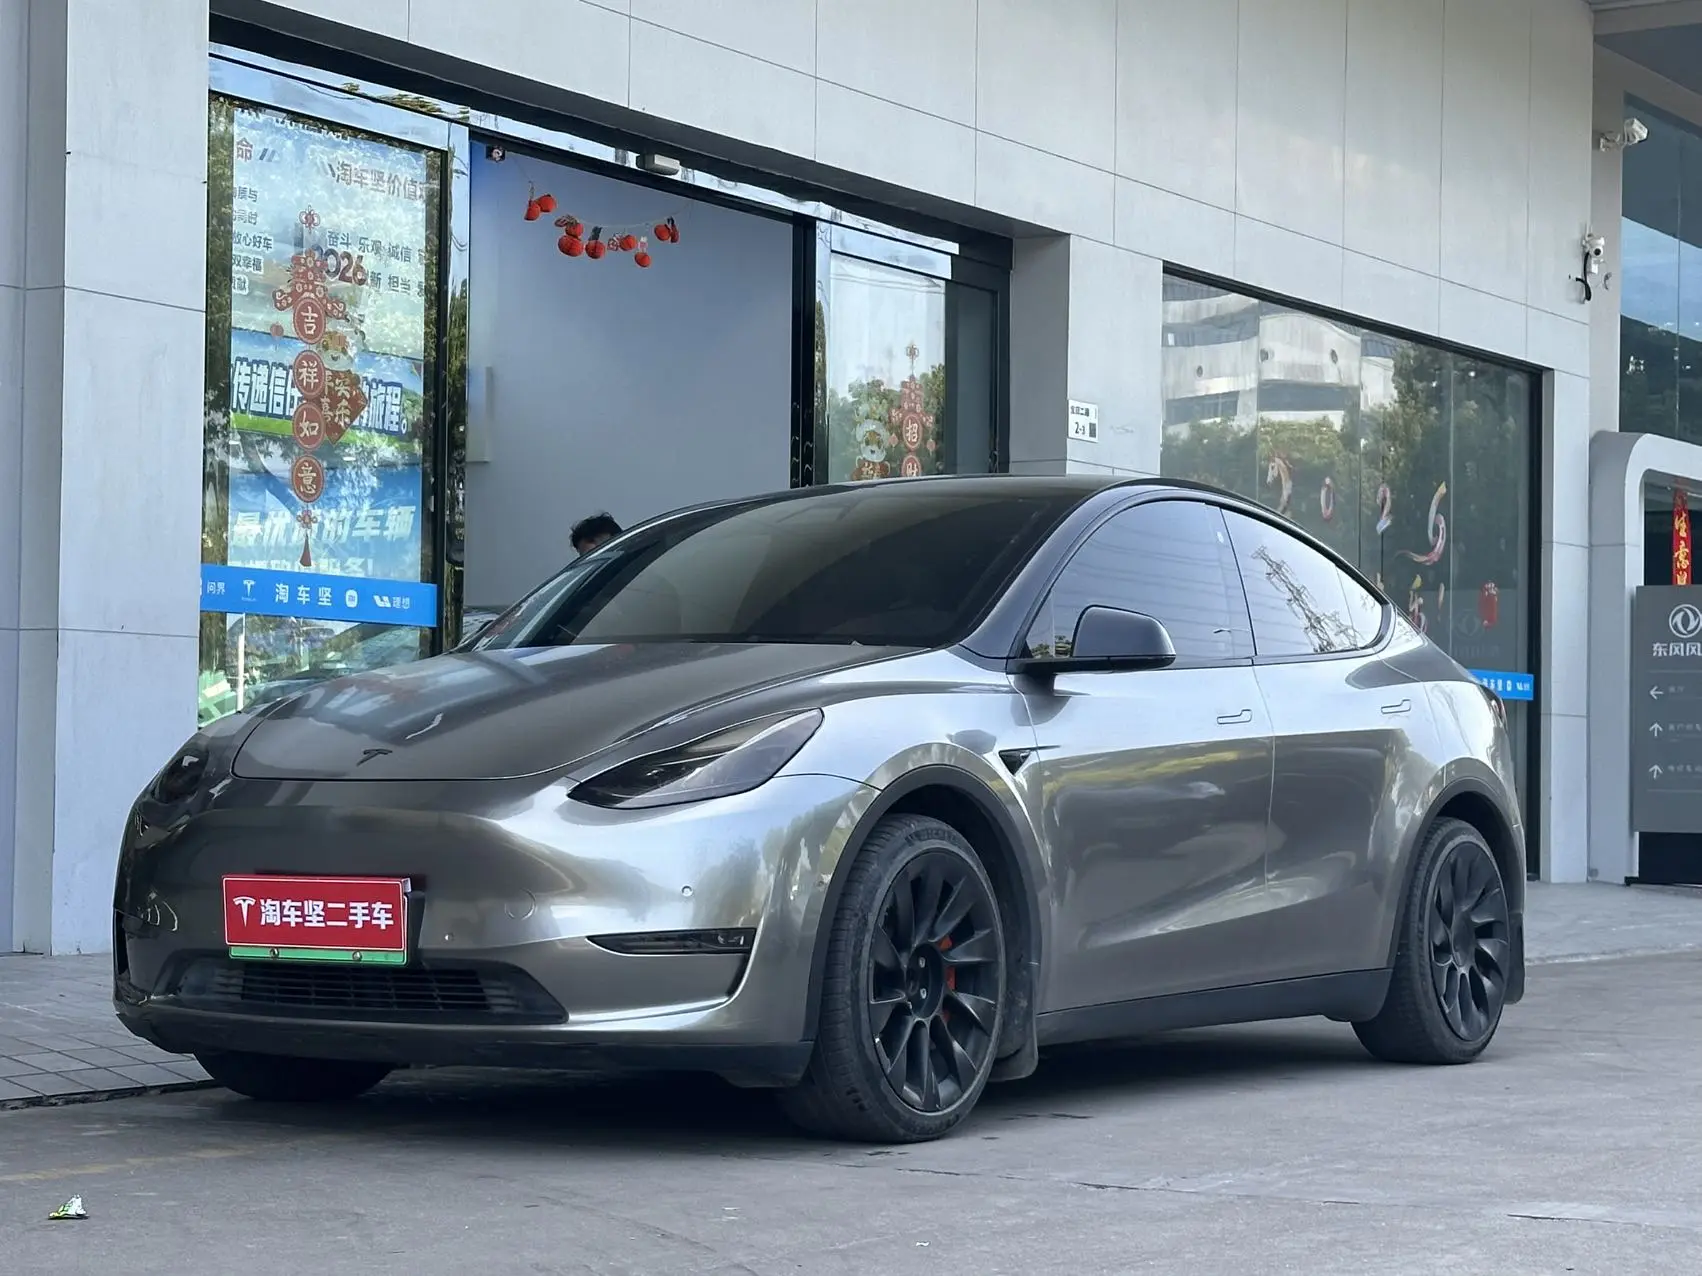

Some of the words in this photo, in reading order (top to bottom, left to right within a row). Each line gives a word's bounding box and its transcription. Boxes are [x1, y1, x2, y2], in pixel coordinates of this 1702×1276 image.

[388, 242, 412, 263] 诚信
[388, 273, 411, 295] 担当
[298, 307, 319, 494] 吉祥如意
[206, 581, 226, 596] 问界
[275, 583, 333, 607] 淘车坚
[1652, 642, 1702, 657] 东风风
[260, 898, 394, 930] 淘车坚二手车
